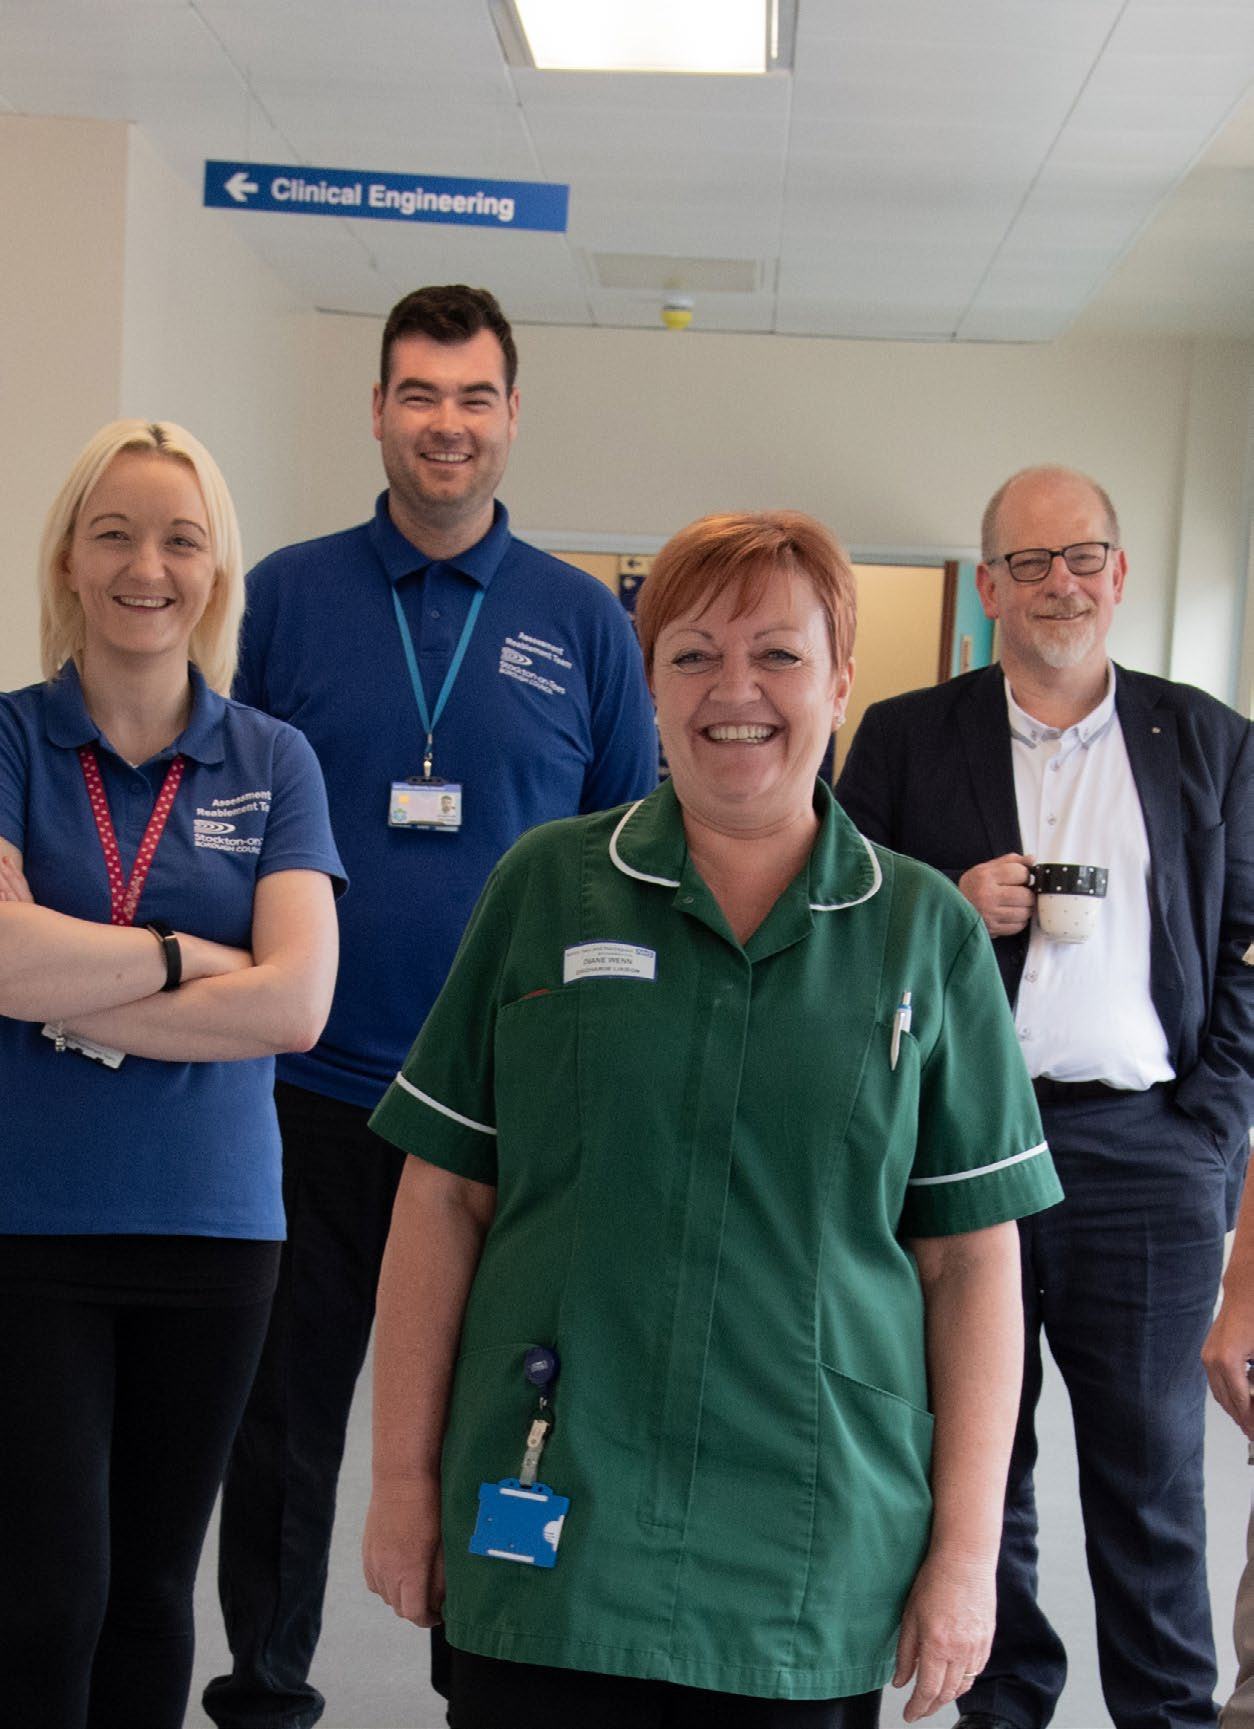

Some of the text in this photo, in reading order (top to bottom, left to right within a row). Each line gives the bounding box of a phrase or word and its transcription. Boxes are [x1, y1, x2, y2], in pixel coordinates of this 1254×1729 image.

[271, 177, 516, 222] Clinical Engineering
[212, 790, 272, 807] Assessment
[196, 802, 258, 817] Reablement
